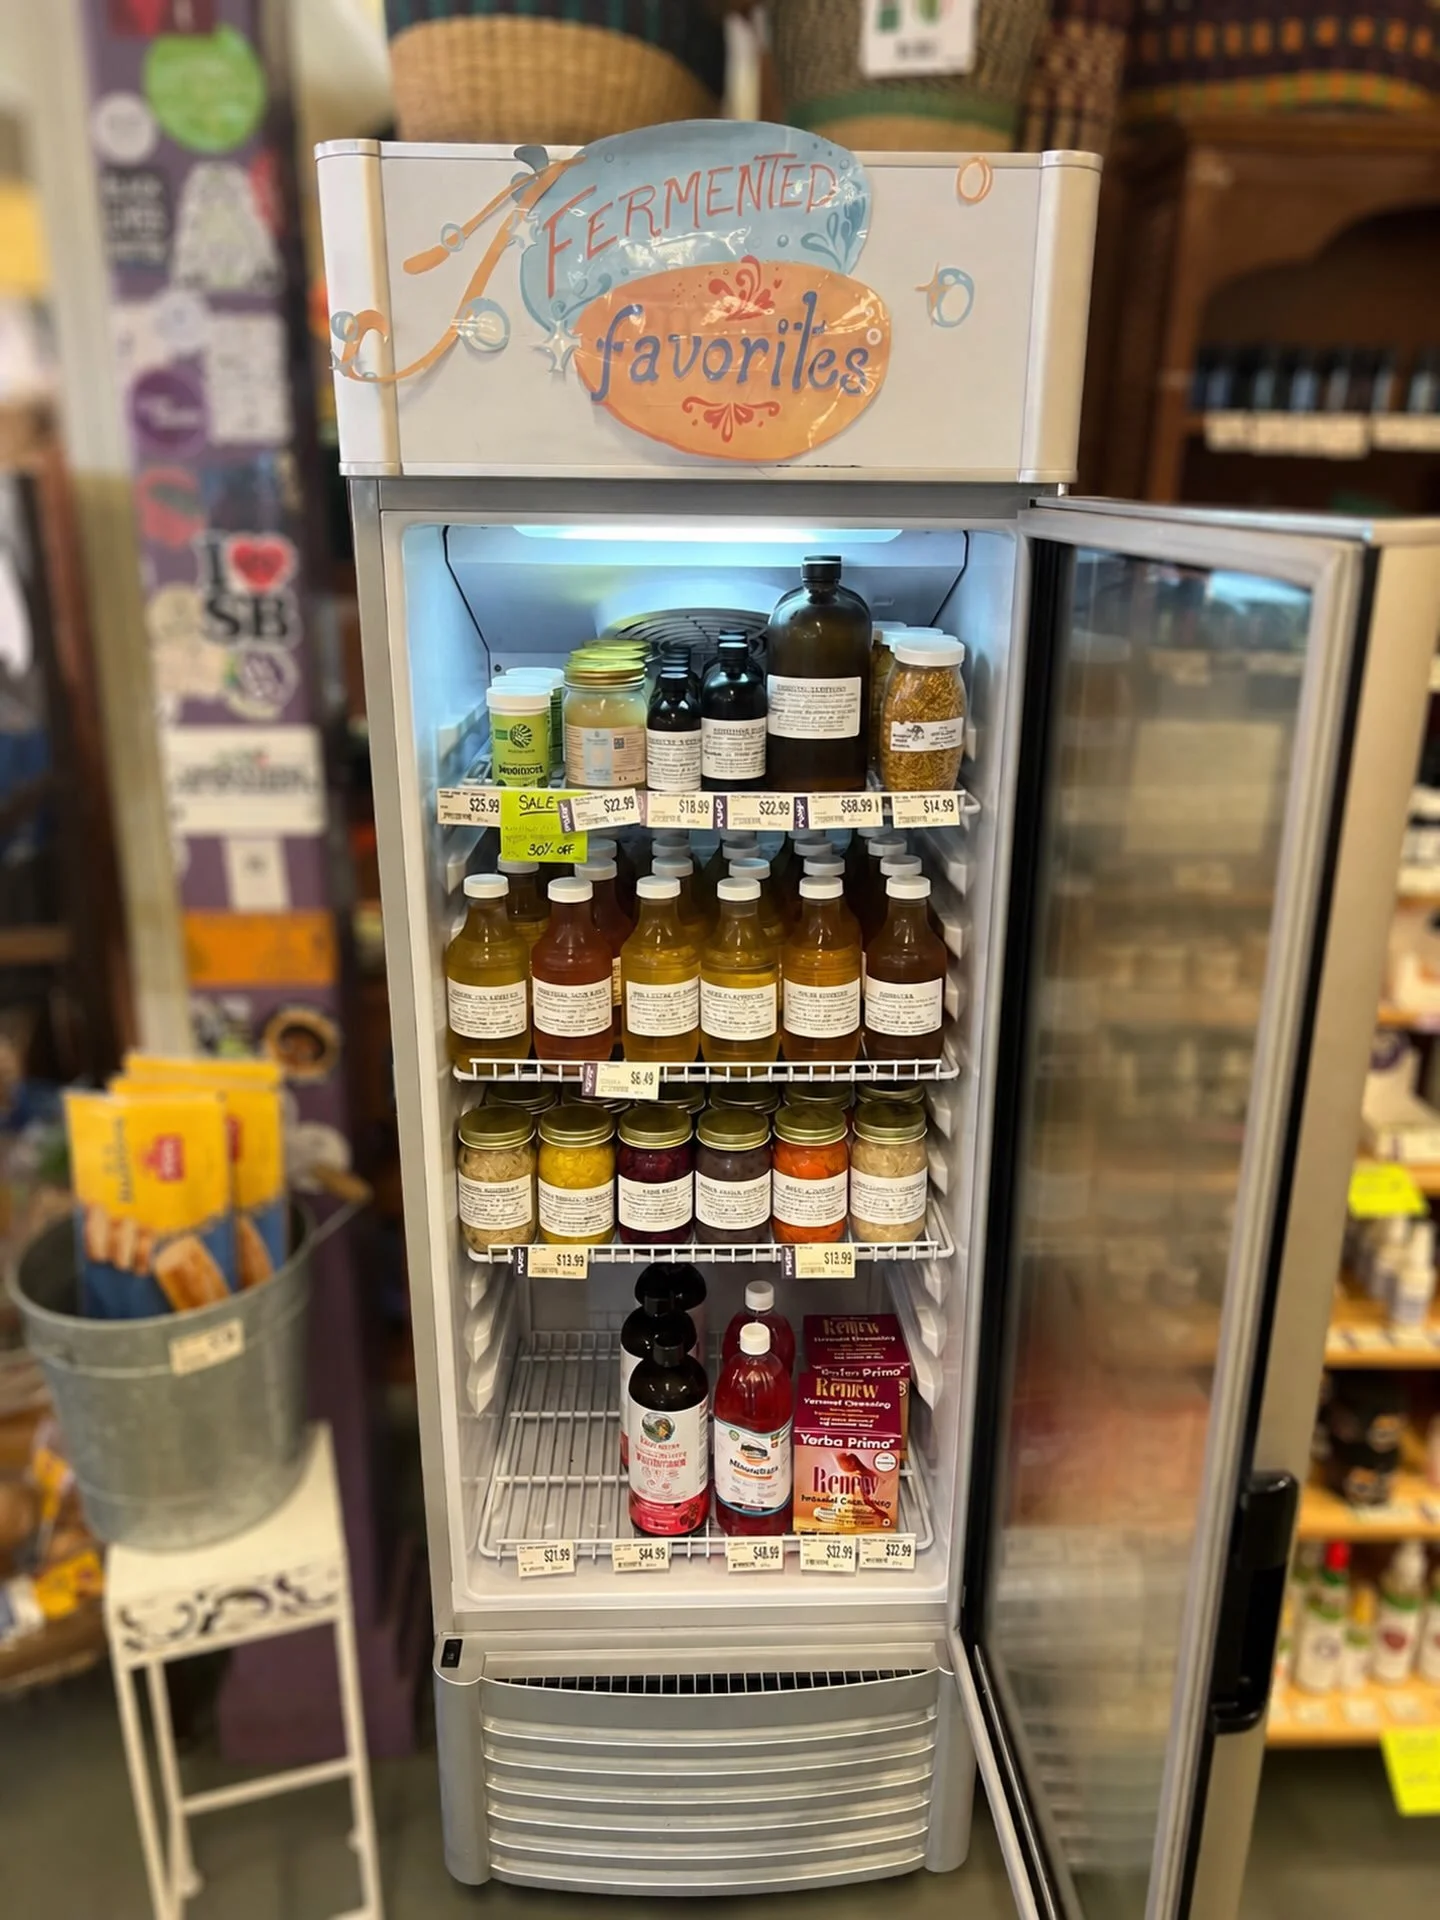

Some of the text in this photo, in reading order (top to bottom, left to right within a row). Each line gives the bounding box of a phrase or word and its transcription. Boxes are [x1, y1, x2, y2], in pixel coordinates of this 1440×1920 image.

[545, 152, 838, 297] FERMENTED
[591, 290, 869, 400] favorites
[469, 797, 500, 813] $25.99
[519, 794, 554, 811] SALE
[604, 795, 635, 813] $22.99
[679, 799, 710, 814] $18.99
[759, 800, 790, 815] $22.99
[528, 842, 553, 856] 30%
[630, 1071, 654, 1086] $6.49
[556, 1253, 585, 1267] $13.99
[816, 1378, 879, 1399] Renew
[813, 1466, 878, 1496] Renew
